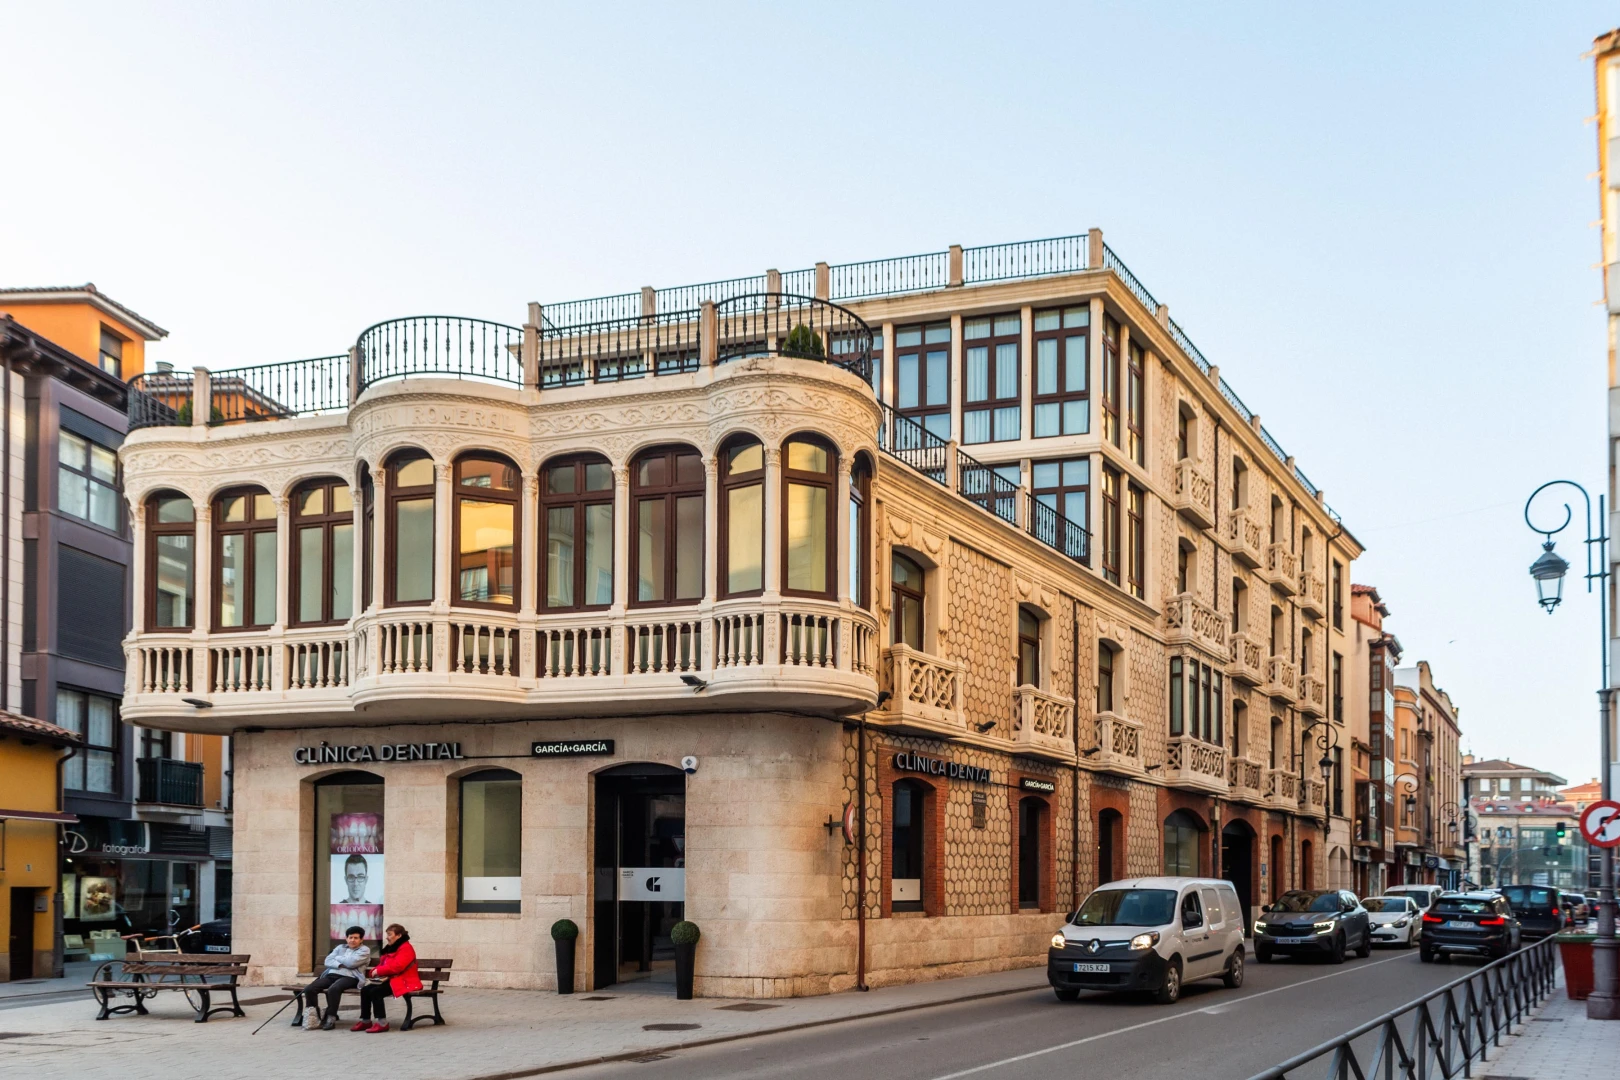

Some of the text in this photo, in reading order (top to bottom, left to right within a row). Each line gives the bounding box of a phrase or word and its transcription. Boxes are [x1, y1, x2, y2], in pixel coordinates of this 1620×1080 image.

[294, 741, 464, 764] CLÍNICA DENTAL
[535, 742, 607, 754] GARCÍA+GARCÍA
[896, 750, 992, 783] CLÍNICA DENTAL
[1078, 964, 1109, 972] 7215 KZJ
